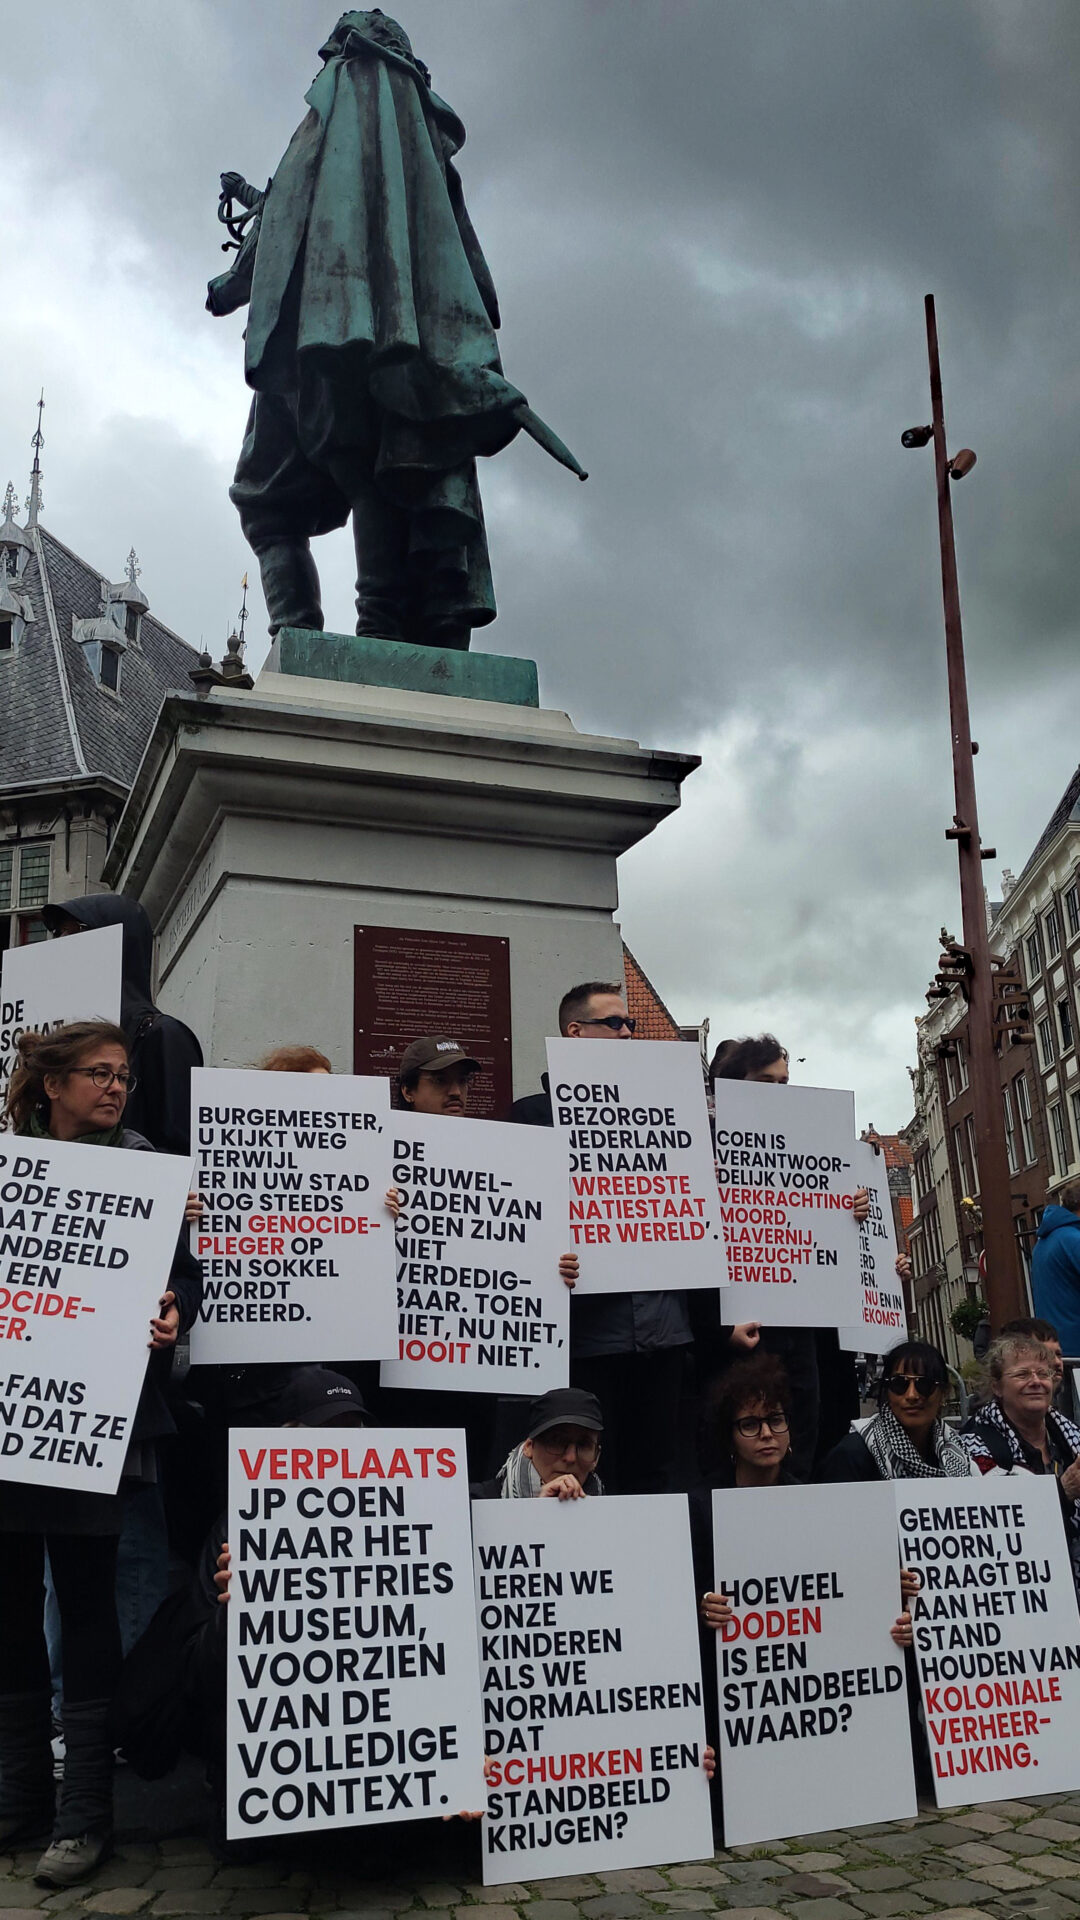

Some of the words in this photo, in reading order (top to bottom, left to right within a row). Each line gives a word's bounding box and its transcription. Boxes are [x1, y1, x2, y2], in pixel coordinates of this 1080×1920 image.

[2, 1000, 24, 1024] DE
[556, 1084, 619, 1103] COEN
[199, 1107, 383, 1133] BURGEMEESTER,
[558, 1107, 675, 1126] BEZORGDE
[199, 1128, 214, 1145] U
[221, 1129, 287, 1147] KIJKT
[293, 1131, 346, 1149] WEG
[394, 1140, 425, 1161] DE
[717, 1130, 766, 1149] COEN
[771, 1134, 785, 1150] IS
[12, 1157, 50, 1180] DE
[198, 1149, 298, 1169] TERWIJL
[597, 1153, 667, 1172] NAAM
[717, 1149, 850, 1172] VERANTWOOR-
[199, 1171, 226, 1189] ER
[233, 1172, 256, 1189] IN
[263, 1172, 303, 1190] UW
[310, 1174, 369, 1191] STAD
[393, 1164, 512, 1192] GRUWEL-
[718, 1168, 775, 1187] DELIJK
[779, 1172, 829, 1190] VOOR
[1, 1182, 60, 1208] ODE
[65, 1190, 153, 1219] STEEN
[199, 1193, 253, 1211] NOG
[260, 1194, 343, 1212] STEEDS
[487, 1197, 541, 1220] VAN
[570, 1199, 705, 1220] NATIESTAAT
[718, 1187, 854, 1209] VERKRACHTING
[51, 1214, 106, 1240] EEN
[198, 1215, 241, 1232] EEN
[248, 1215, 380, 1234] GENOCIDE-
[396, 1214, 463, 1237] COEN
[471, 1219, 525, 1243] ZIJN
[720, 1207, 791, 1228] MOORD,
[872, 1222, 888, 1239] ZAL
[198, 1237, 284, 1255] PLEGER
[291, 1237, 323, 1255] OP
[570, 1224, 611, 1244] TER
[199, 1259, 241, 1277] EEN
[249, 1259, 339, 1277] SOKKEL
[817, 1250, 837, 1265] EN
[6, 1262, 61, 1289] EEN
[861, 1271, 878, 1288] EN.
[203, 1281, 290, 1299] WORDT
[865, 1290, 878, 1306] NU
[880, 1292, 891, 1308] EN
[892, 1295, 902, 1310] IN
[199, 1304, 311, 1322] VEREERD.
[475, 1293, 541, 1318] TOEN
[863, 1307, 903, 1328] EKOMST.
[459, 1317, 495, 1340] NU
[503, 1320, 563, 1348] NIET,
[478, 1344, 540, 1368] NIET.
[21, 1405, 87, 1434] DAT
[90, 1414, 127, 1440] ZE
[29, 1436, 103, 1468] ZIEN.
[239, 1448, 456, 1480] VERPLAATS
[239, 1488, 286, 1520] JP
[297, 1486, 404, 1519] COEN
[900, 1505, 1025, 1532] GEMEENTE
[240, 1526, 353, 1561] NAAR
[365, 1524, 433, 1557] HET
[903, 1534, 1001, 1561] HOORN,
[1006, 1533, 1022, 1556] U
[478, 1544, 545, 1570] WAT
[239, 1562, 453, 1603] WESTFRIES
[480, 1572, 563, 1600] LEREN
[570, 1570, 613, 1595] WE
[906, 1562, 1009, 1590] DRAAGT
[1015, 1560, 1051, 1584] BIJ
[721, 1572, 843, 1607] HOEVEEL
[481, 1602, 556, 1630] ONZE
[913, 1594, 968, 1620] AAN
[972, 1591, 1016, 1617] HET
[1022, 1589, 1048, 1613] IN
[240, 1604, 426, 1646] MUSEUM,
[721, 1606, 821, 1640] DODEN
[916, 1622, 1001, 1652] STAND
[482, 1628, 622, 1661] KINDEREN
[238, 1643, 445, 1689] VOORZIEN
[723, 1648, 747, 1677] IS
[756, 1641, 807, 1673] EEN
[921, 1650, 1026, 1683] HOUDEN
[1029, 1645, 1080, 1672] VAN
[483, 1664, 534, 1692] ALS
[542, 1660, 587, 1687] WE
[724, 1665, 903, 1712] STANDBEELD
[484, 1682, 701, 1724] NORMALISEREN
[925, 1677, 1062, 1714] KOLONIALE
[237, 1693, 329, 1733] VAN
[343, 1688, 391, 1725] DE
[724, 1703, 852, 1747] WAARD?
[929, 1710, 1050, 1745] VERHEER-
[237, 1725, 458, 1778] VOLLEDIGE
[484, 1725, 544, 1757] DAT
[484, 1748, 642, 1787] SCHURKEN
[650, 1743, 699, 1771] EEN
[935, 1743, 1038, 1778] LIJKING.
[238, 1770, 448, 1826] CONTEXT.
[487, 1777, 670, 1820] STANDBEELD
[488, 1811, 628, 1853] KRIJGEN?
